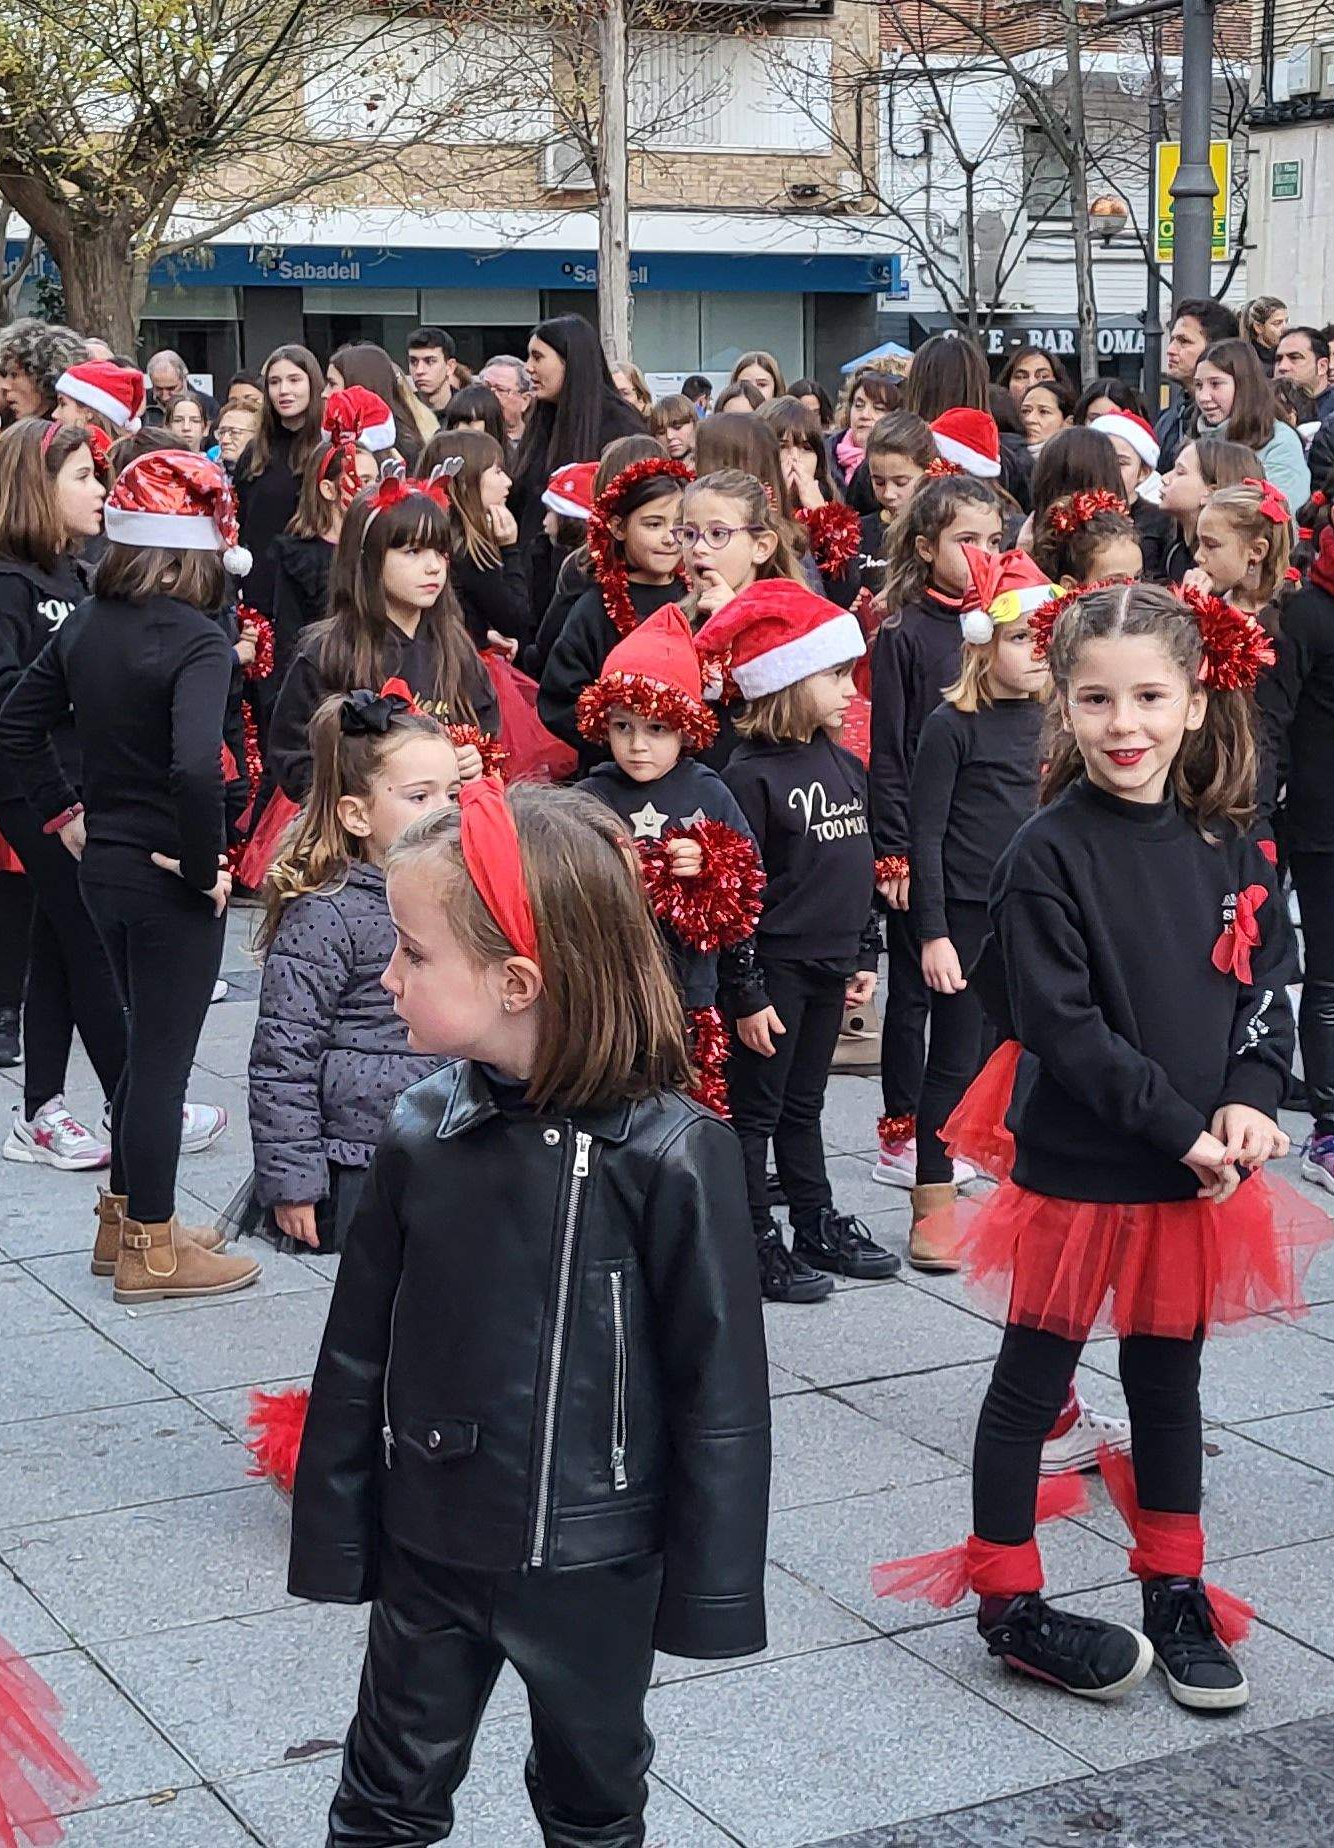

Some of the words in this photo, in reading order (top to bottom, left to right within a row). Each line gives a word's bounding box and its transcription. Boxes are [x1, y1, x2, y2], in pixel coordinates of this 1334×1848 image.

[1160, 219, 1226, 238] OE
[279, 261, 360, 280] Sabadell
[573, 264, 648, 283] Saell
[1028, 329, 1076, 354] BAR
[811, 819, 845, 843] TOO
